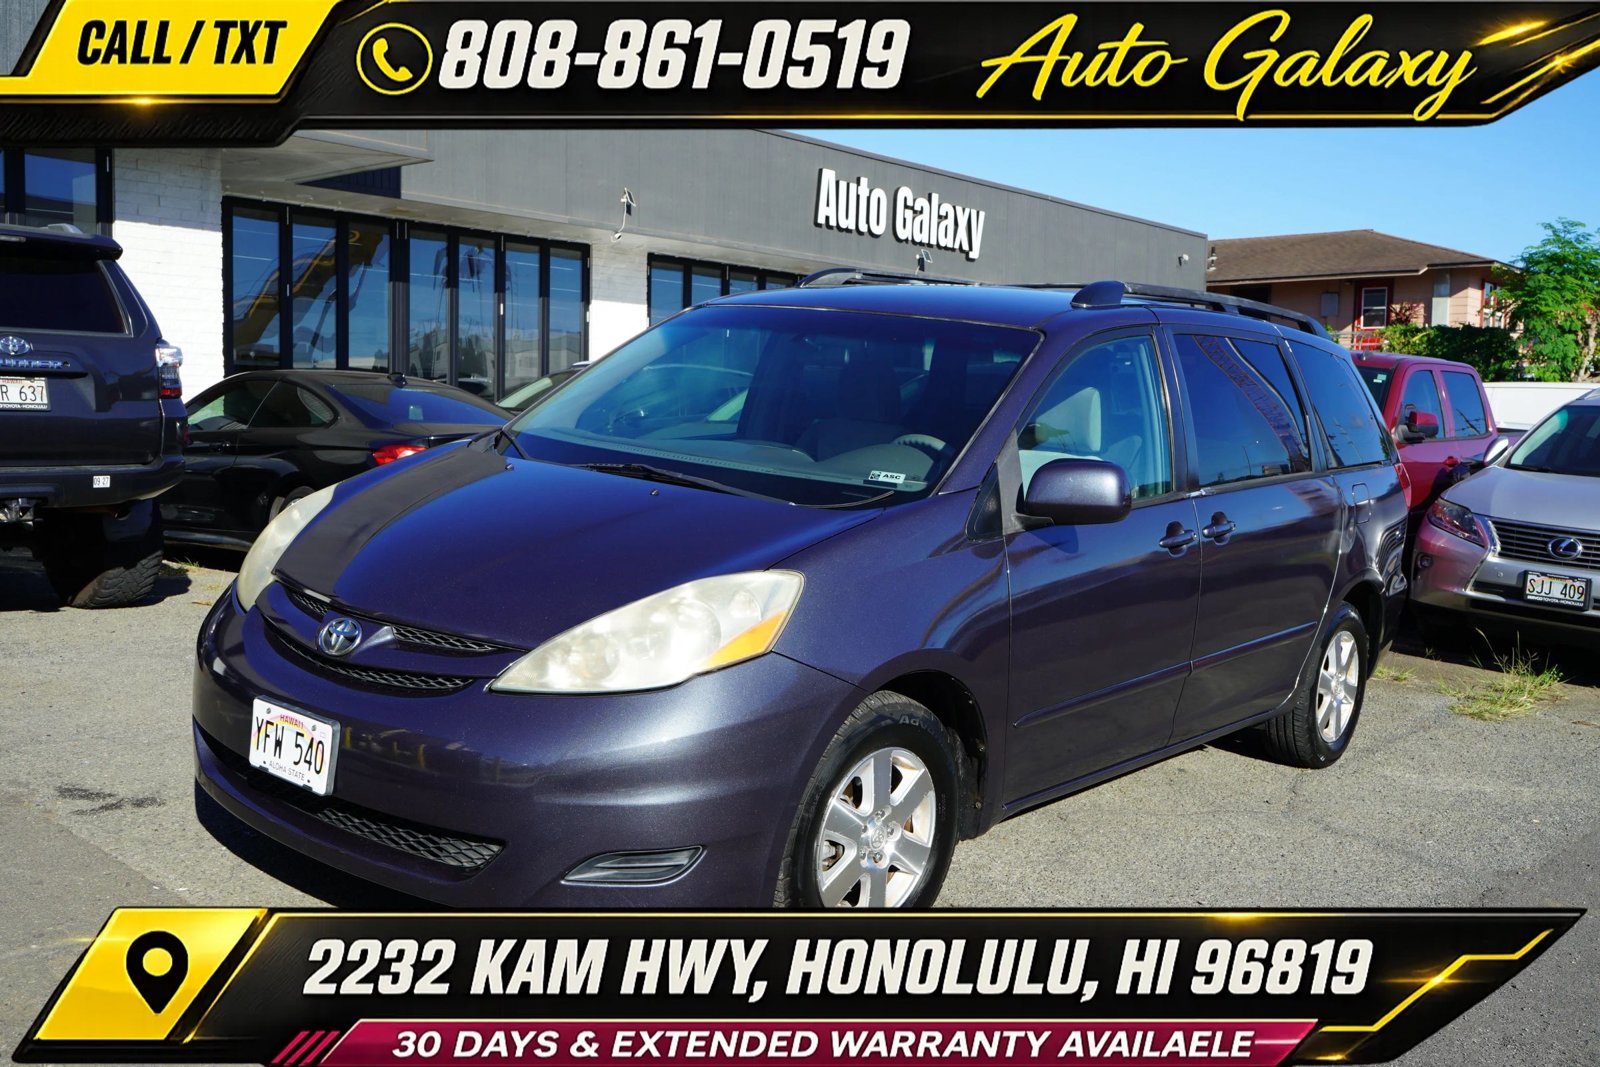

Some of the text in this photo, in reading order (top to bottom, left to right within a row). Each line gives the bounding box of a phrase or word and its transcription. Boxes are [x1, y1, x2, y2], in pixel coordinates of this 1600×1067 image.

[815, 167, 986, 261] Auto Galaxy
[19, 385, 45, 402] 637
[1527, 578, 1585, 600] SJJ 409
[280, 713, 304, 729] HAWAII
[256, 716, 325, 775] YFW 540
[269, 760, 305, 781] ALOHA STATE
